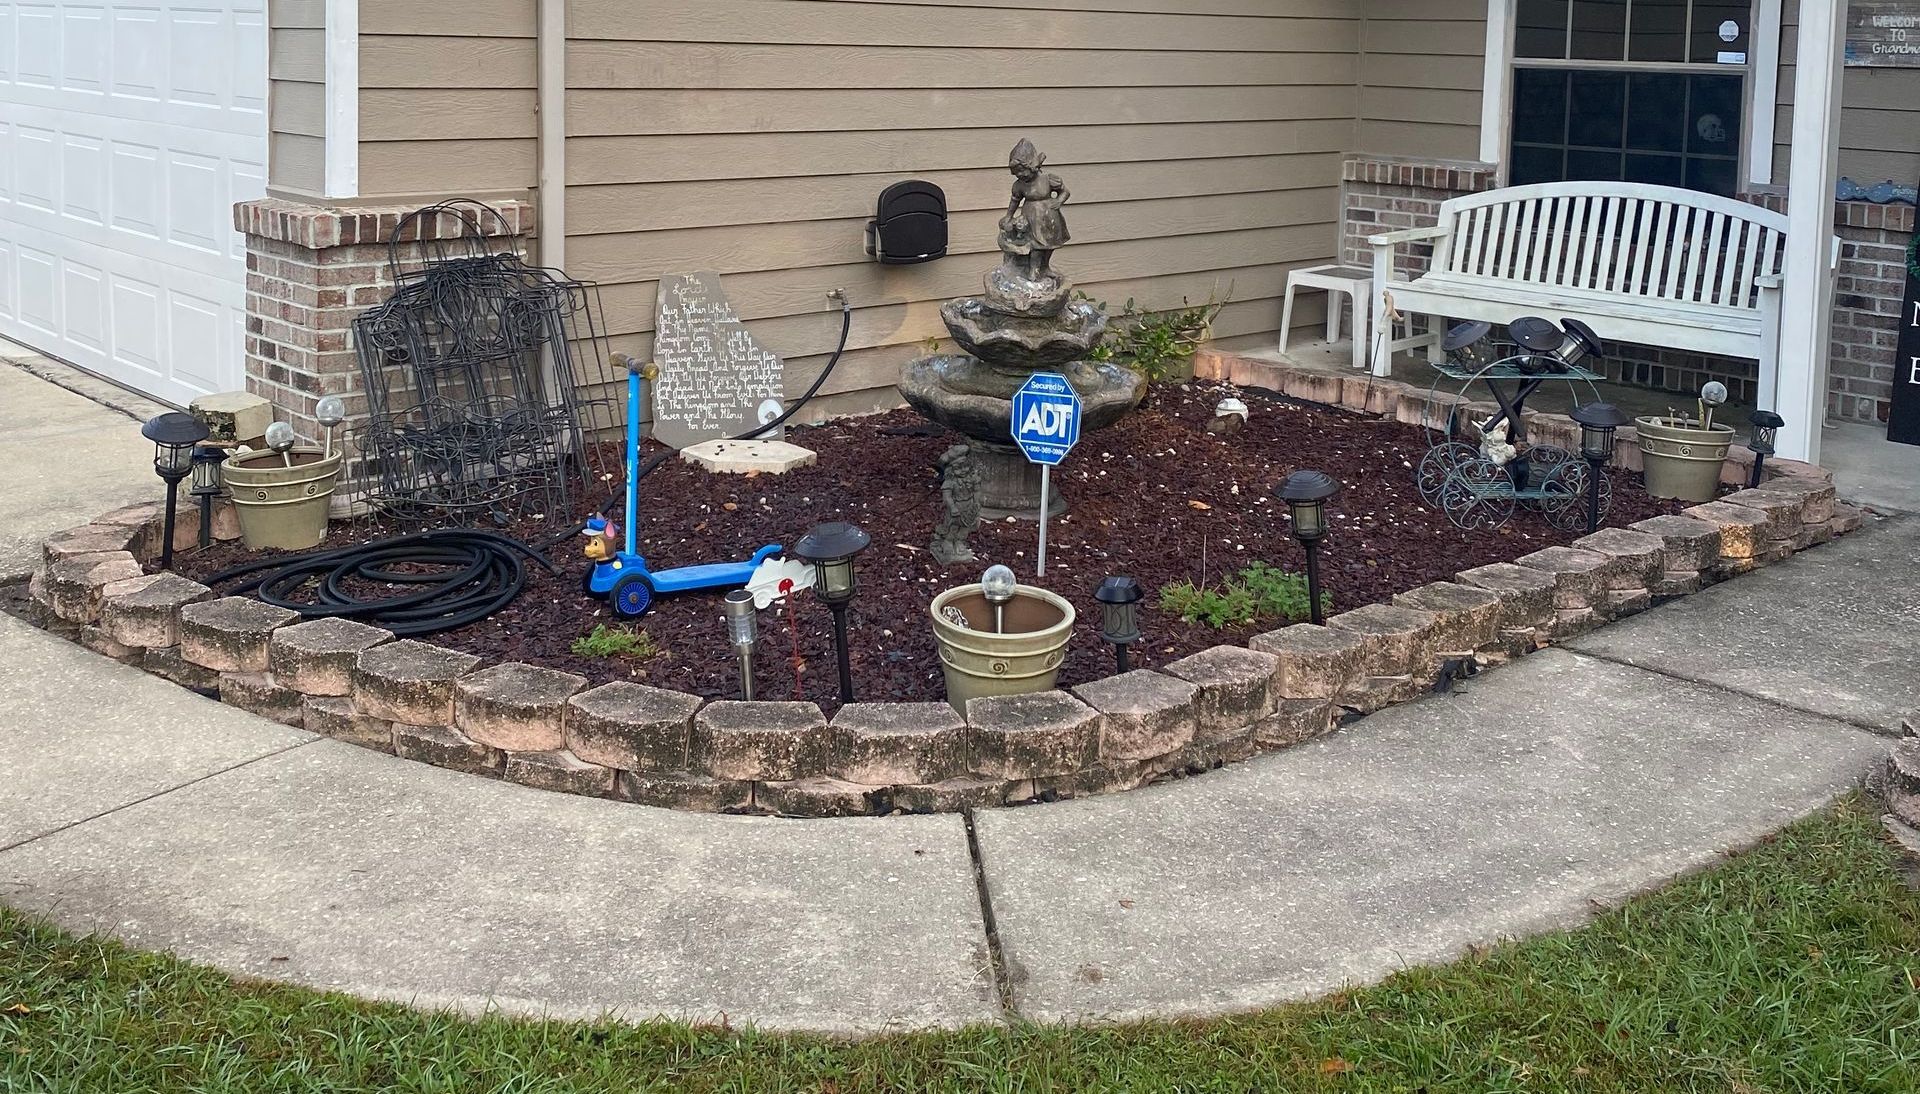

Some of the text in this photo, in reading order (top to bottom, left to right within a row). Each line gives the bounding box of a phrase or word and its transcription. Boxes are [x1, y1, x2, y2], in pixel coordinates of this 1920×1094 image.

[1890, 28, 1906, 42] TO
[684, 274, 701, 285] The
[663, 302, 731, 316] Our Father Which
[690, 341, 712, 352] Earth
[730, 350, 745, 361] This
[747, 351, 761, 362] Day
[763, 351, 776, 361] Our
[687, 361, 708, 372] Bread
[713, 361, 729, 371] And
[771, 360, 784, 370] Our
[656, 381, 672, 391] And
[675, 380, 694, 391] Lead
[1030, 381, 1066, 393] Secured by
[656, 390, 669, 400] But
[673, 390, 699, 400] Deliver
[702, 390, 711, 399] Us
[713, 390, 733, 399] From
[756, 390, 767, 398] For
[669, 400, 682, 410] The
[685, 399, 719, 412] Kingdom
[740, 399, 753, 409] The
[660, 409, 680, 420] Power
[704, 408, 717, 420] The
[1021, 401, 1073, 438] ADT
[687, 420, 698, 430] For
